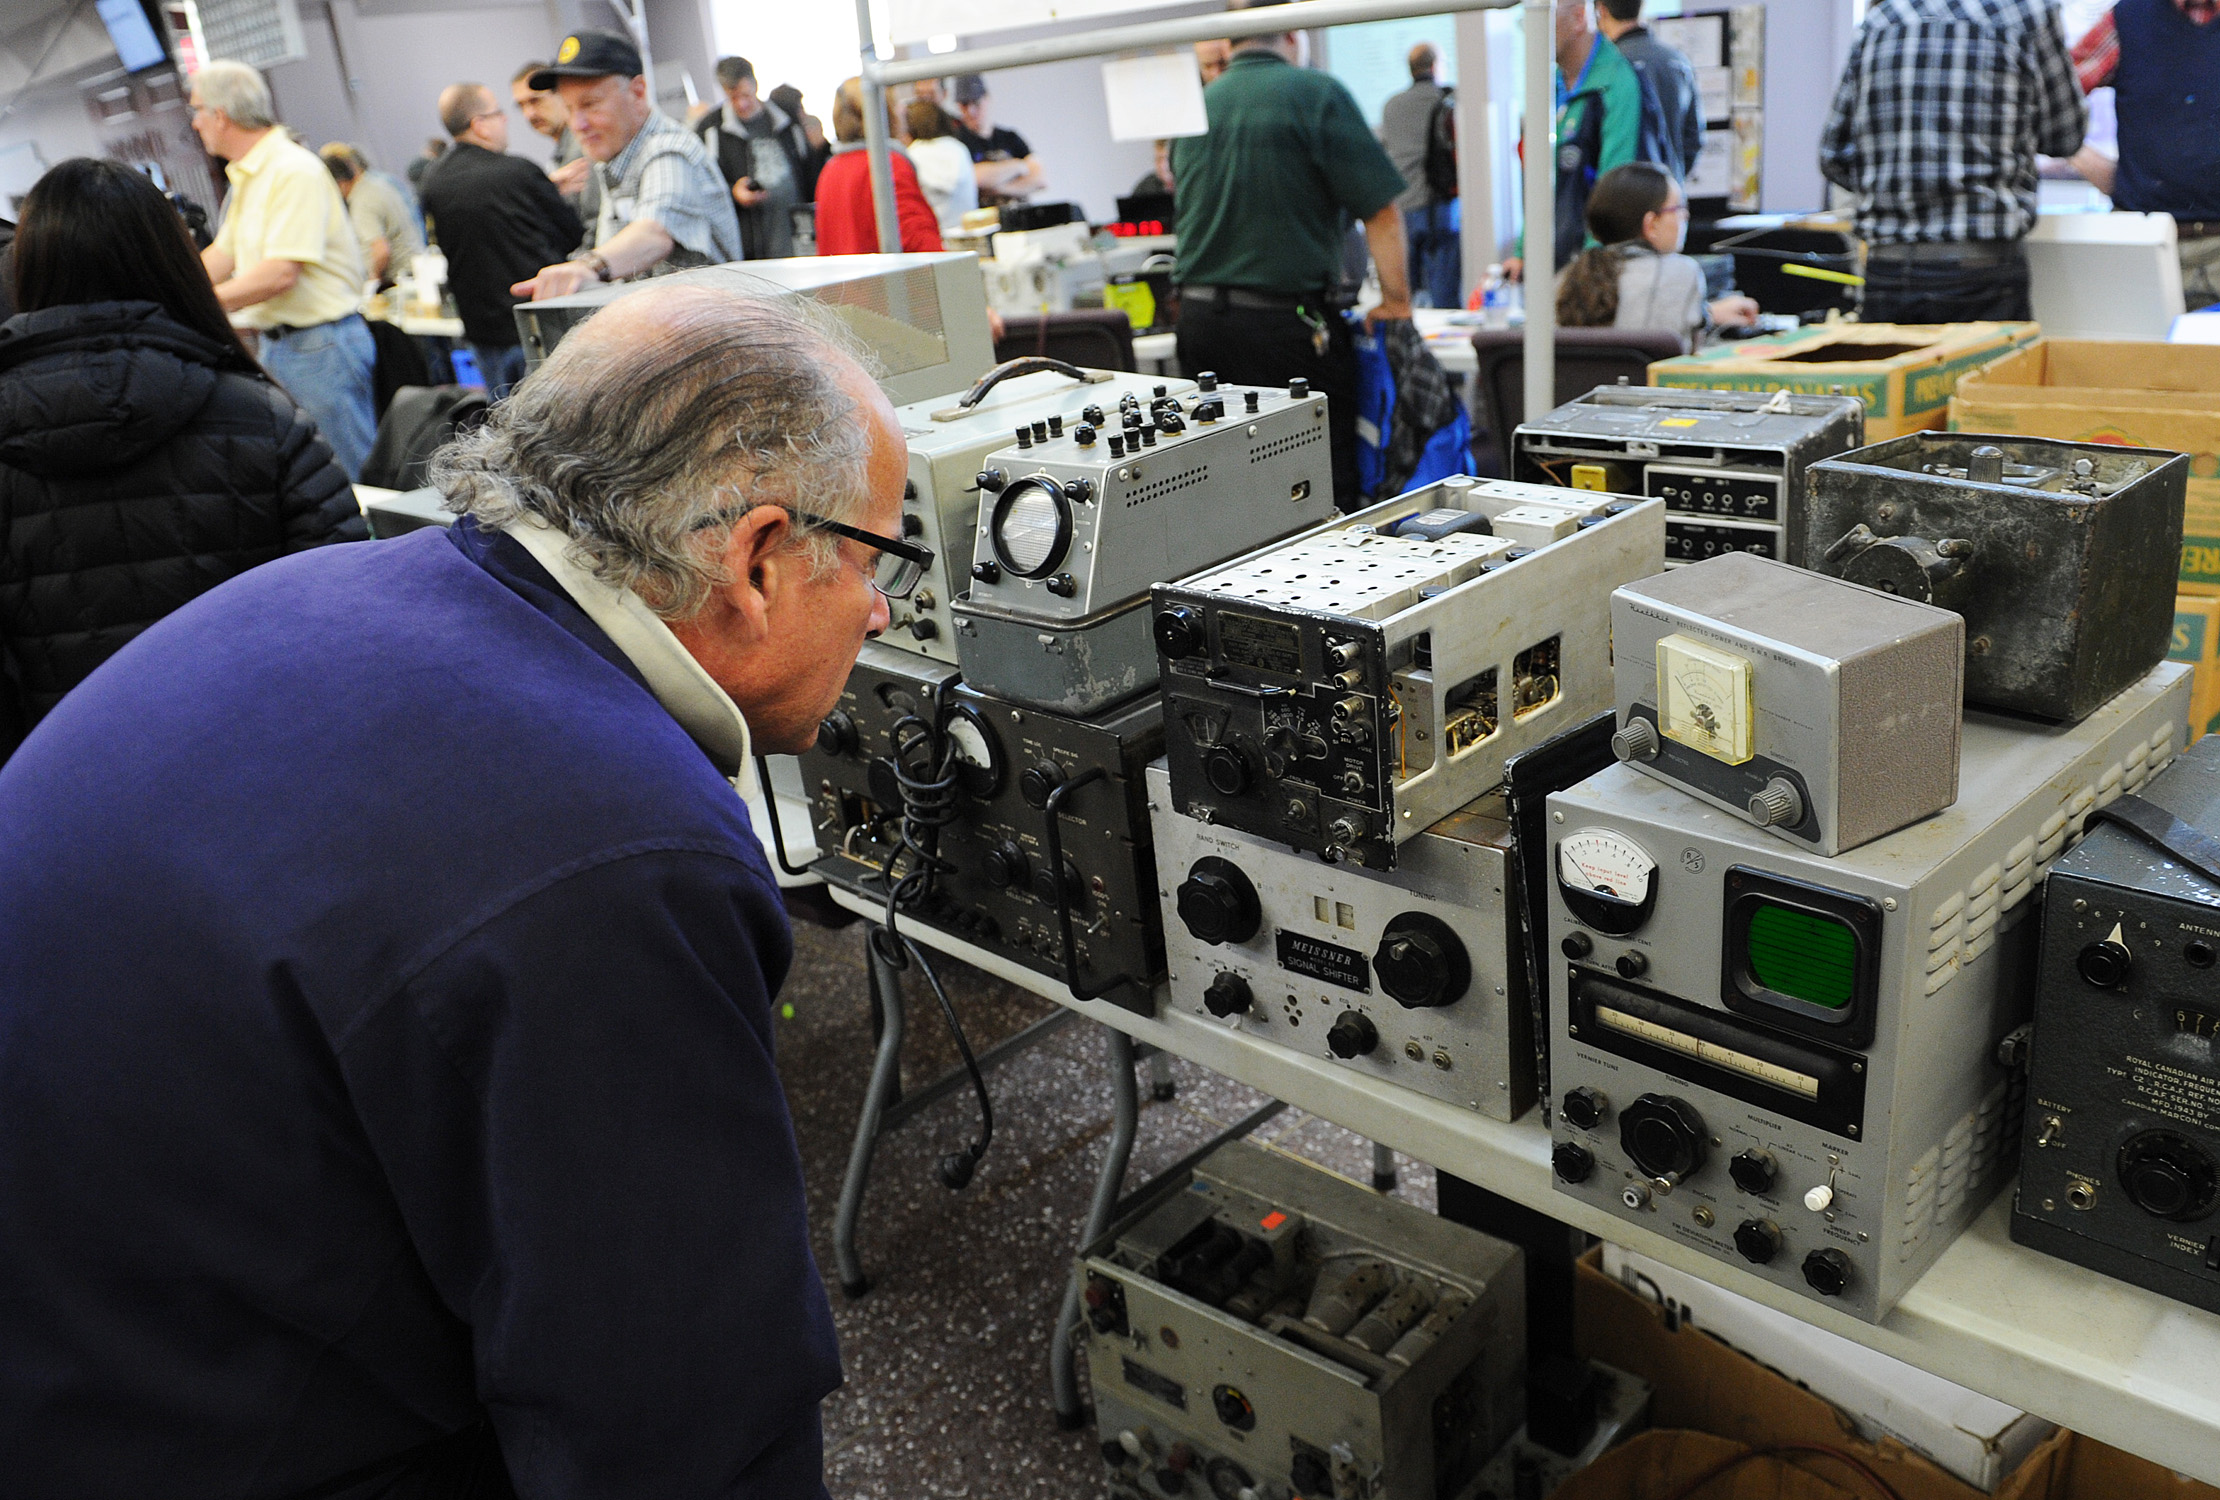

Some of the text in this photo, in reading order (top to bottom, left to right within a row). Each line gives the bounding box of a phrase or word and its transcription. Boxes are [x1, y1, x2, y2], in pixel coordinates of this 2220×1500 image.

[1629, 602, 1670, 623] Heathkit
[1677, 621, 1708, 637] REFLECTED
[1711, 633, 1731, 644] POWER
[1735, 640, 1748, 650] AND
[1773, 655, 1797, 668] BRIDGE
[1358, 746, 1373, 754] USE
[1344, 757, 1364, 767] MOTOR
[1346, 763, 1363, 772] DRIVE
[1058, 812, 1087, 826] SELECTOR
[1216, 839, 1240, 850] SWITCH
[1581, 862, 1629, 879] Keep input level
[1585, 872, 1627, 886] above red line
[1409, 889, 1437, 902] TUNING
[1292, 940, 1351, 966] MEISSNER
[1288, 956, 1359, 986] SIGNAL SHIFTER
[2177, 1011, 2185, 1021] 6
[2197, 1014, 2204, 1024] 7
[1577, 1052, 1619, 1071] VERNIER TUNE
[2126, 1055, 2152, 1069] ROYAL
[2155, 1064, 2198, 1081] CANADIAN
[2200, 1077, 2215, 1086] AIR
[1665, 1075, 1689, 1087] TUNING
[2132, 1075, 2144, 1083] C2
[2188, 1091, 2206, 1101] REF.
[2037, 1098, 2072, 1114] BATTERY
[2122, 1098, 2157, 1113] CANADIAN
[2160, 1109, 2202, 1126] MARCONI
[2174, 1105, 2195, 1116] 1943
[2197, 1111, 2209, 1120] BY
[1747, 1114, 1782, 1131] MULTIPLIER
[1822, 1142, 1849, 1156] MARKER
[2051, 1140, 2067, 1148] OFF
[2066, 1170, 2101, 1186] PHONES
[1823, 1228, 1860, 1247] FREQUENCY
[1830, 1225, 1851, 1236] SWEEP
[1683, 1226, 1714, 1242] DEVIATION
[1714, 1239, 1734, 1251] METER
[2167, 1233, 2206, 1250] VERNIER
[2170, 1242, 2200, 1256] INDEX
